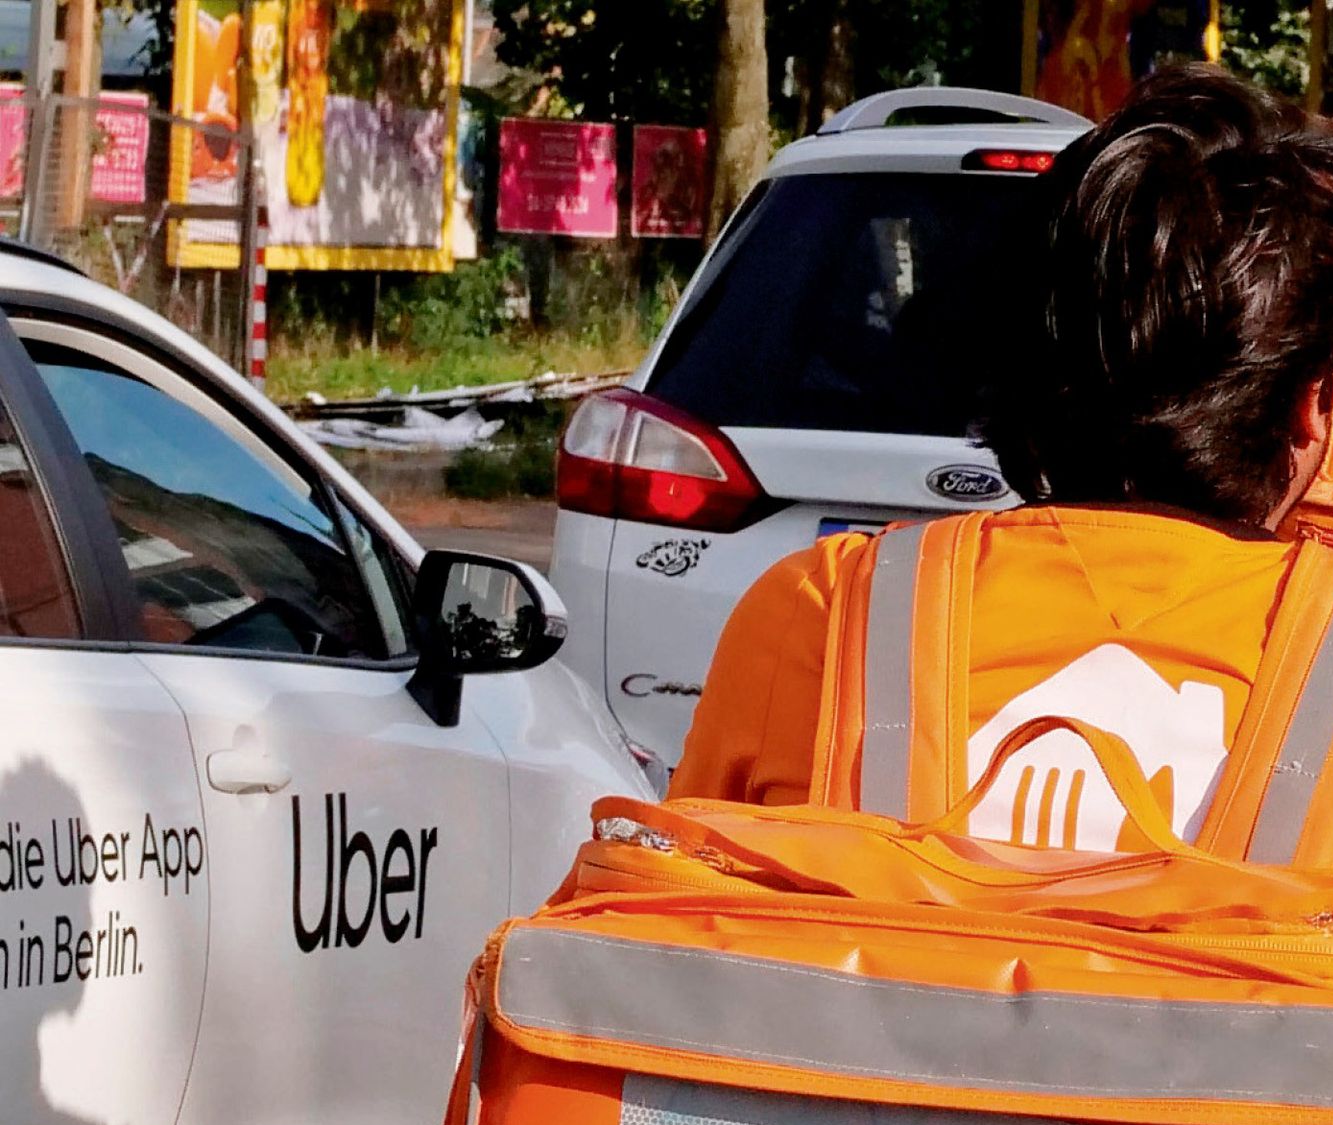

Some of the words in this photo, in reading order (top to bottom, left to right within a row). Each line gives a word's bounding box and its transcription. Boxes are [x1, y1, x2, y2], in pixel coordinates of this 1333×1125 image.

[943, 472, 992, 493] Ford
[0, 822, 45, 892] die
[52, 817, 130, 887] Uber
[139, 813, 203, 896] App
[291, 792, 438, 953] Uber
[17, 919, 45, 988] in
[53, 911, 143, 984] Berlin.
